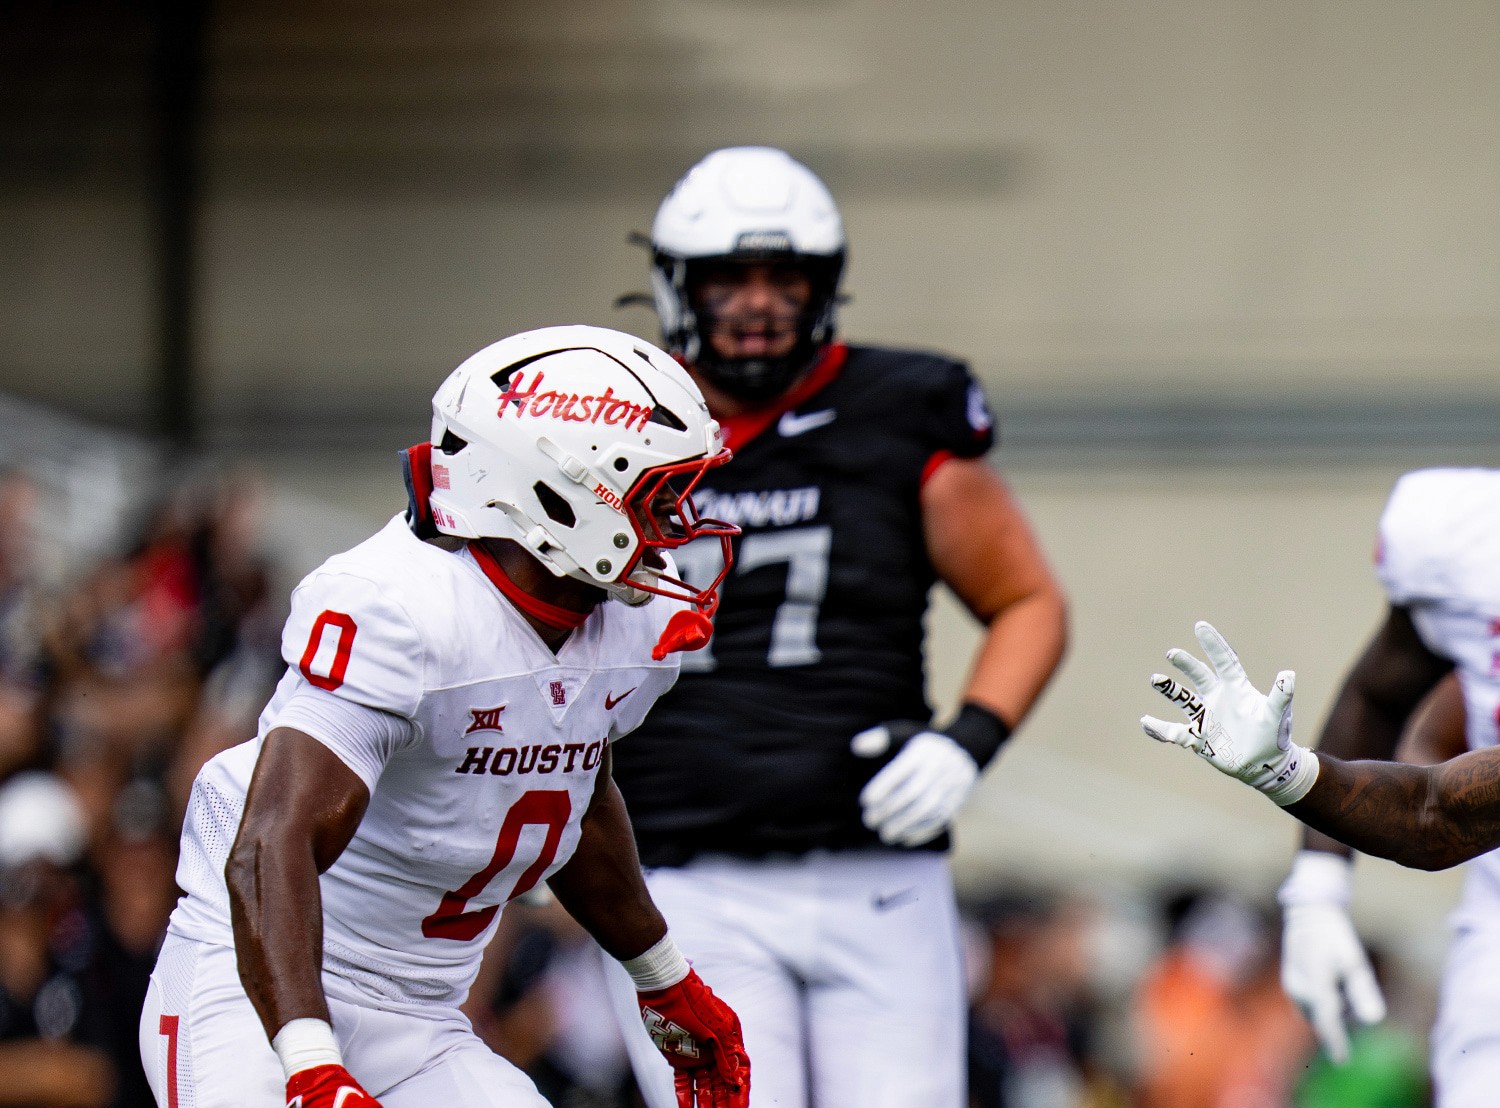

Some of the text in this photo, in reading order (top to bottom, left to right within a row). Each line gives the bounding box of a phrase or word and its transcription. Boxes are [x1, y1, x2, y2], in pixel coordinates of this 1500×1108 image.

[497, 371, 653, 433] Houston
[593, 483, 627, 515] HOUS
[300, 609, 358, 692] 0
[1154, 678, 1206, 735] ALPHA
[421, 789, 572, 942] 0
